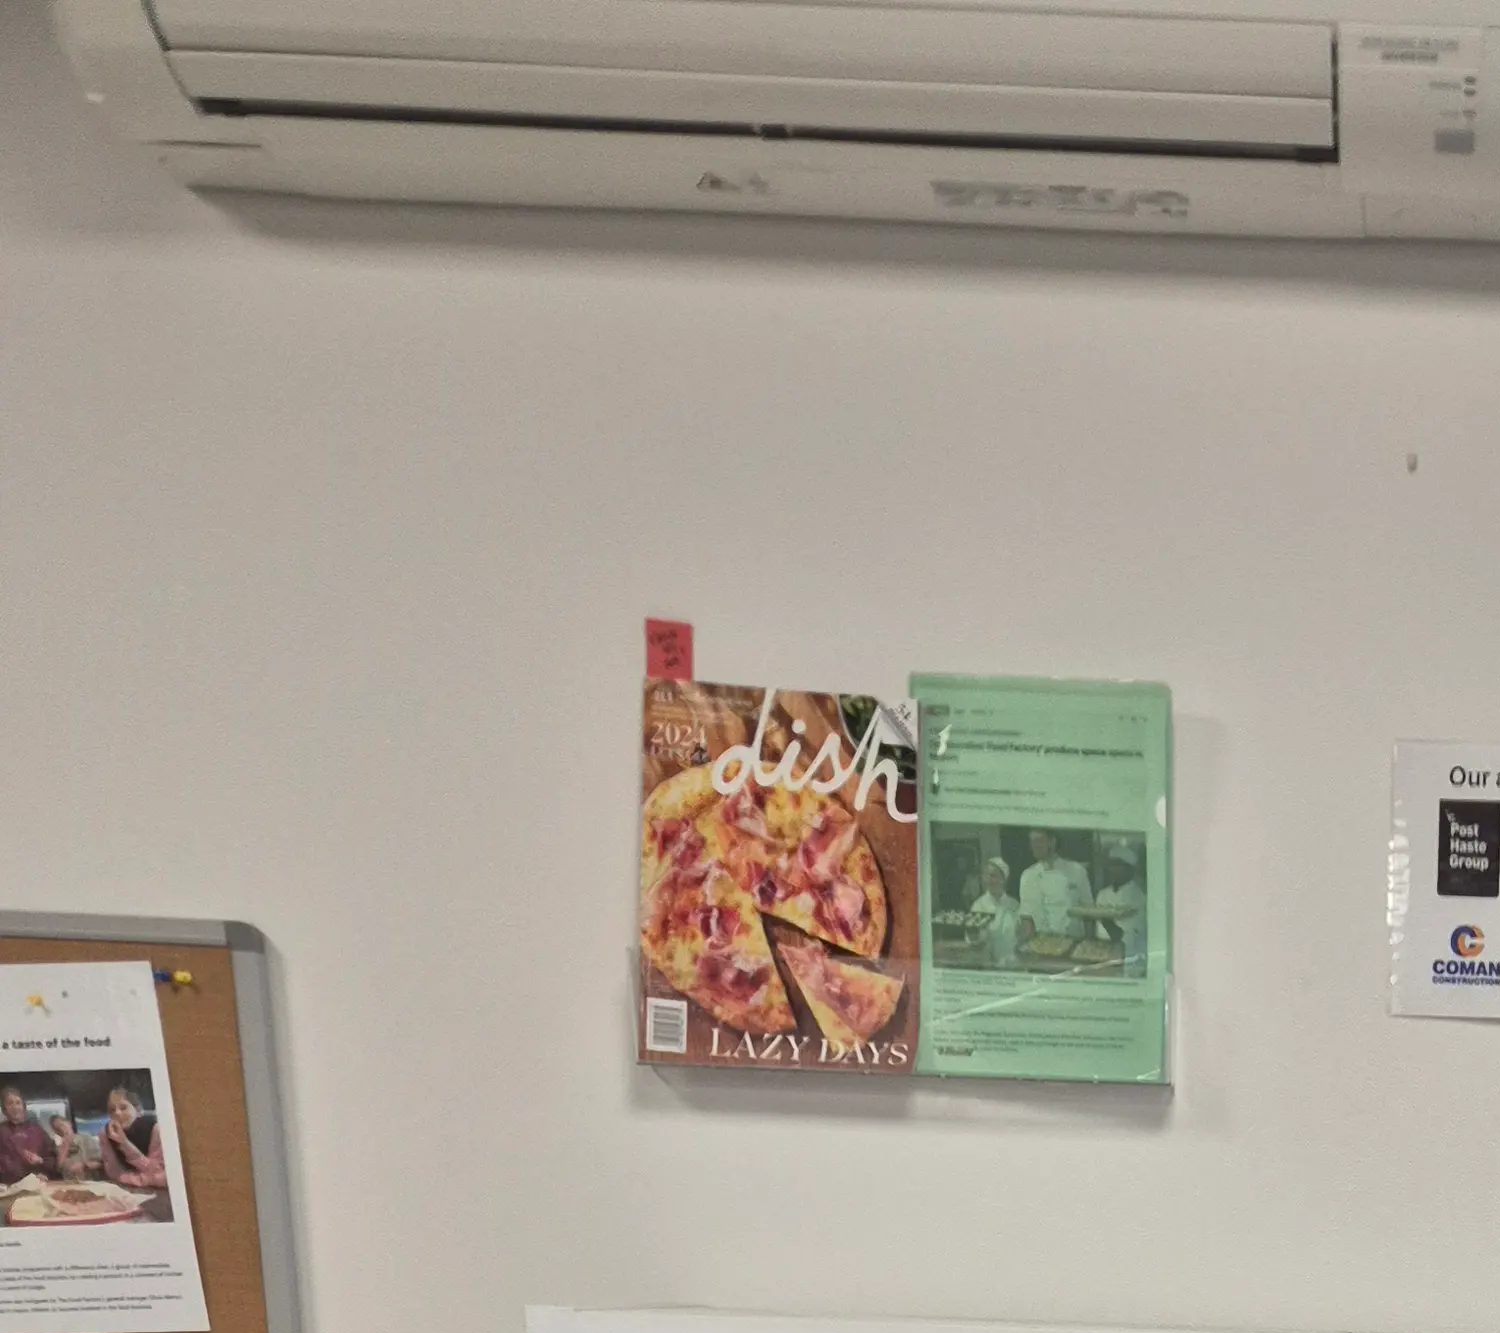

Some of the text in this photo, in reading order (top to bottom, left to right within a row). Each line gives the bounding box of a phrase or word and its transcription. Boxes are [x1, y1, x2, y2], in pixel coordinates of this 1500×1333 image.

[711, 687, 917, 822] dish
[1449, 766, 1490, 788] Our
[1450, 822, 1479, 837] Post
[1450, 838, 1487, 854] Haste
[1449, 854, 1489, 872] Group
[12, 1039, 43, 1050] taste
[45, 1037, 58, 1049] of
[61, 1037, 81, 1049] the
[84, 1035, 111, 1048] food
[708, 1027, 810, 1062] LAZY
[818, 1036, 909, 1066] DAYS
